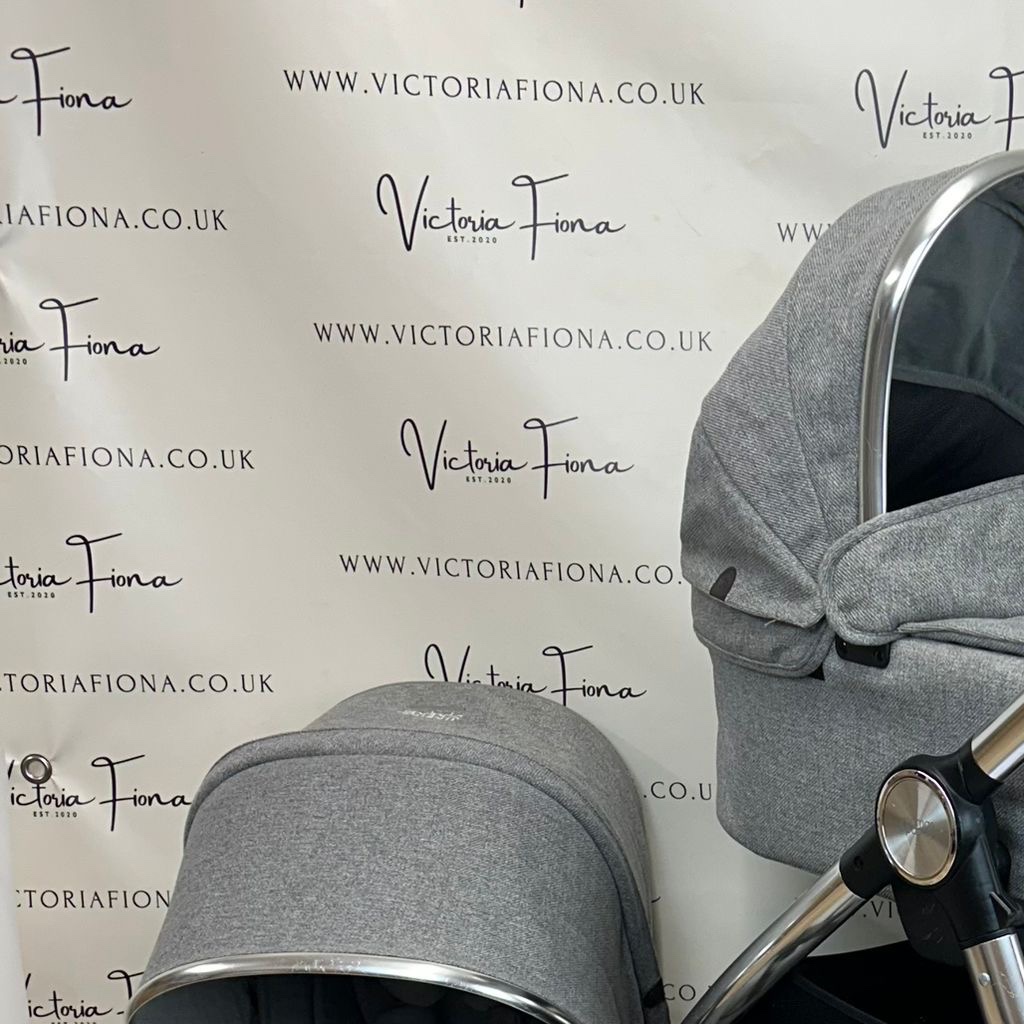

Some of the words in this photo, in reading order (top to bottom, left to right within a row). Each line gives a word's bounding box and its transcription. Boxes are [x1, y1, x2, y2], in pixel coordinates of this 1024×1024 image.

[11, 46, 132, 136] Fiona
[283, 69, 706, 105] WWW.VICTORIAFIONA.CO.UK
[855, 68, 991, 149] Victoria
[923, 131, 972, 139] EST.2020
[376, 173, 516, 252] Victoria
[511, 174, 627, 260] Fiona
[777, 221, 833, 242] WW
[447, 235, 498, 244] EST.2020
[39, 297, 161, 382] Fiona
[313, 323, 712, 352] WWW.VICTORIAFIONA.CO.UK
[400, 418, 528, 490] Victoria
[523, 416, 635, 500] Fiona
[465, 476, 512, 484] EST.2020
[65, 533, 182, 613] Fiona
[339, 554, 682, 585] WWW.VICTORIAFIONA.CO.
[8, 591, 55, 599] EST.2020
[0, 673, 275, 694] TORIAFIONA.CO.UK
[542, 645, 647, 706] Fiona
[7, 759, 96, 809] ictoria
[91, 755, 194, 832] Fiona
[25, 973, 114, 1020] ictoria
